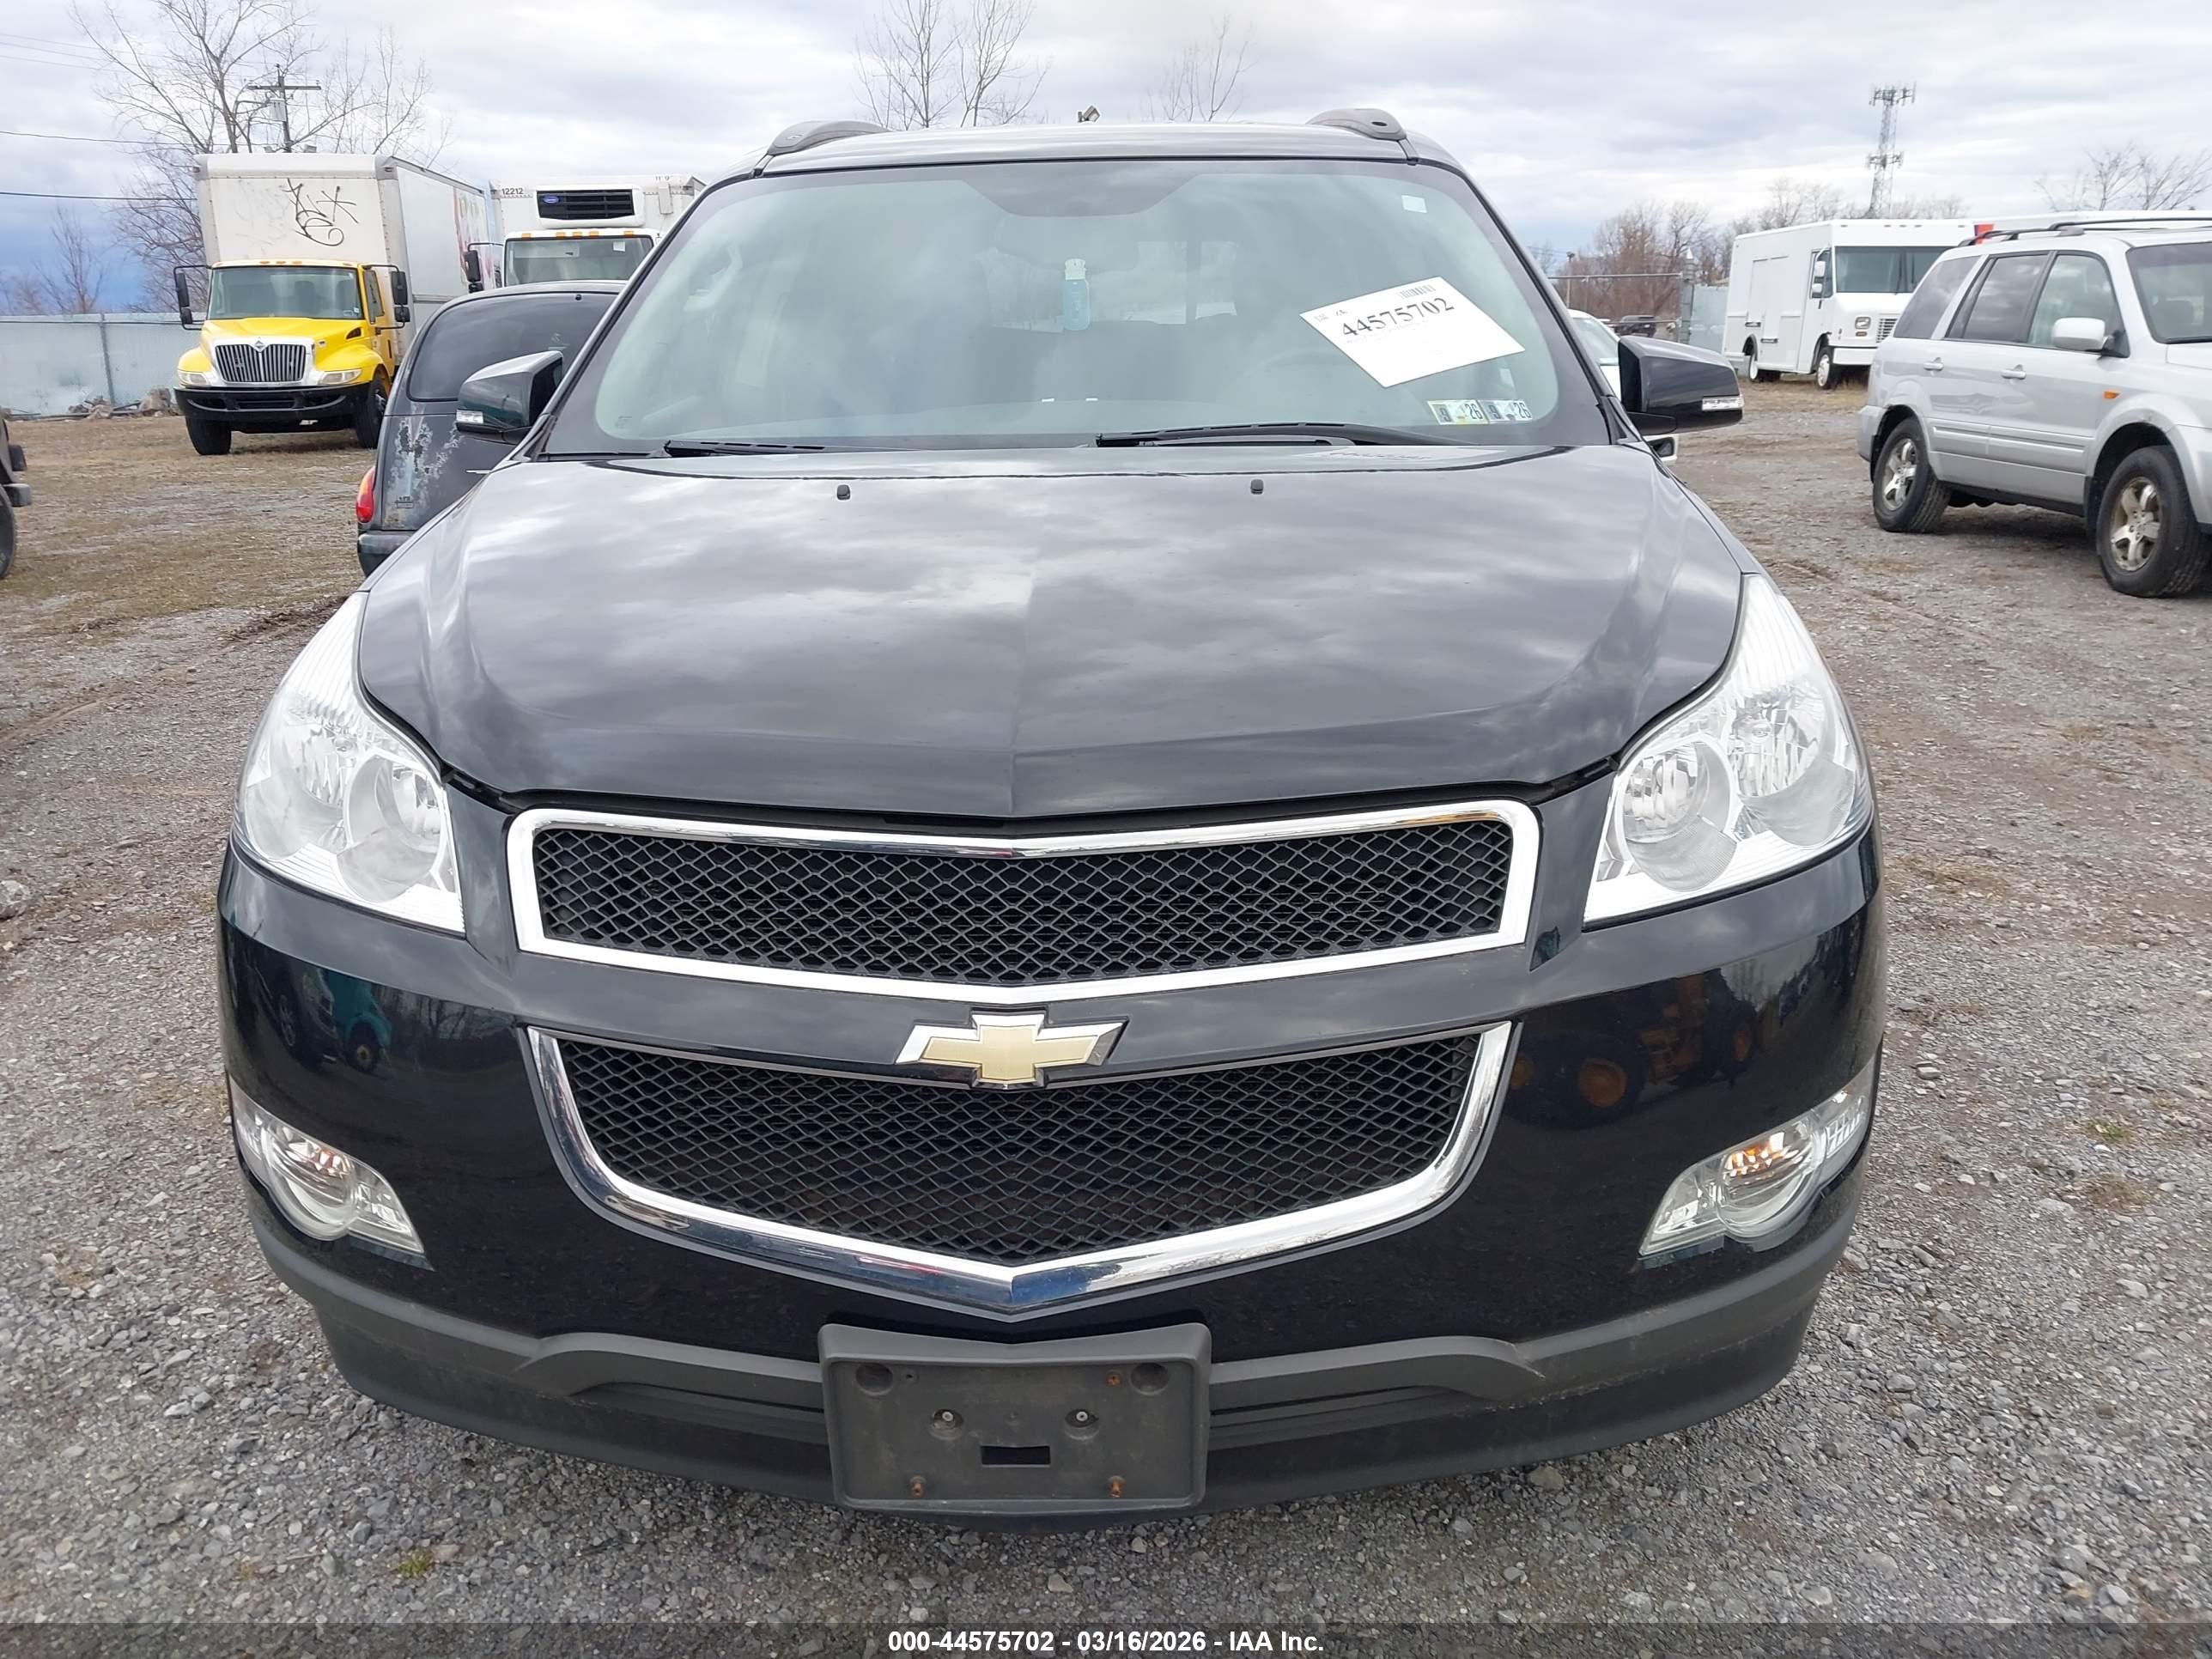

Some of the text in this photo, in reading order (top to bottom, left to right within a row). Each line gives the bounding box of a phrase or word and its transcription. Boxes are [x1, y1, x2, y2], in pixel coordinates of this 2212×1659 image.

[1342, 297, 1455, 336] 44575702
[1465, 403, 1483, 420] 26
[1513, 402, 1531, 419] 26
